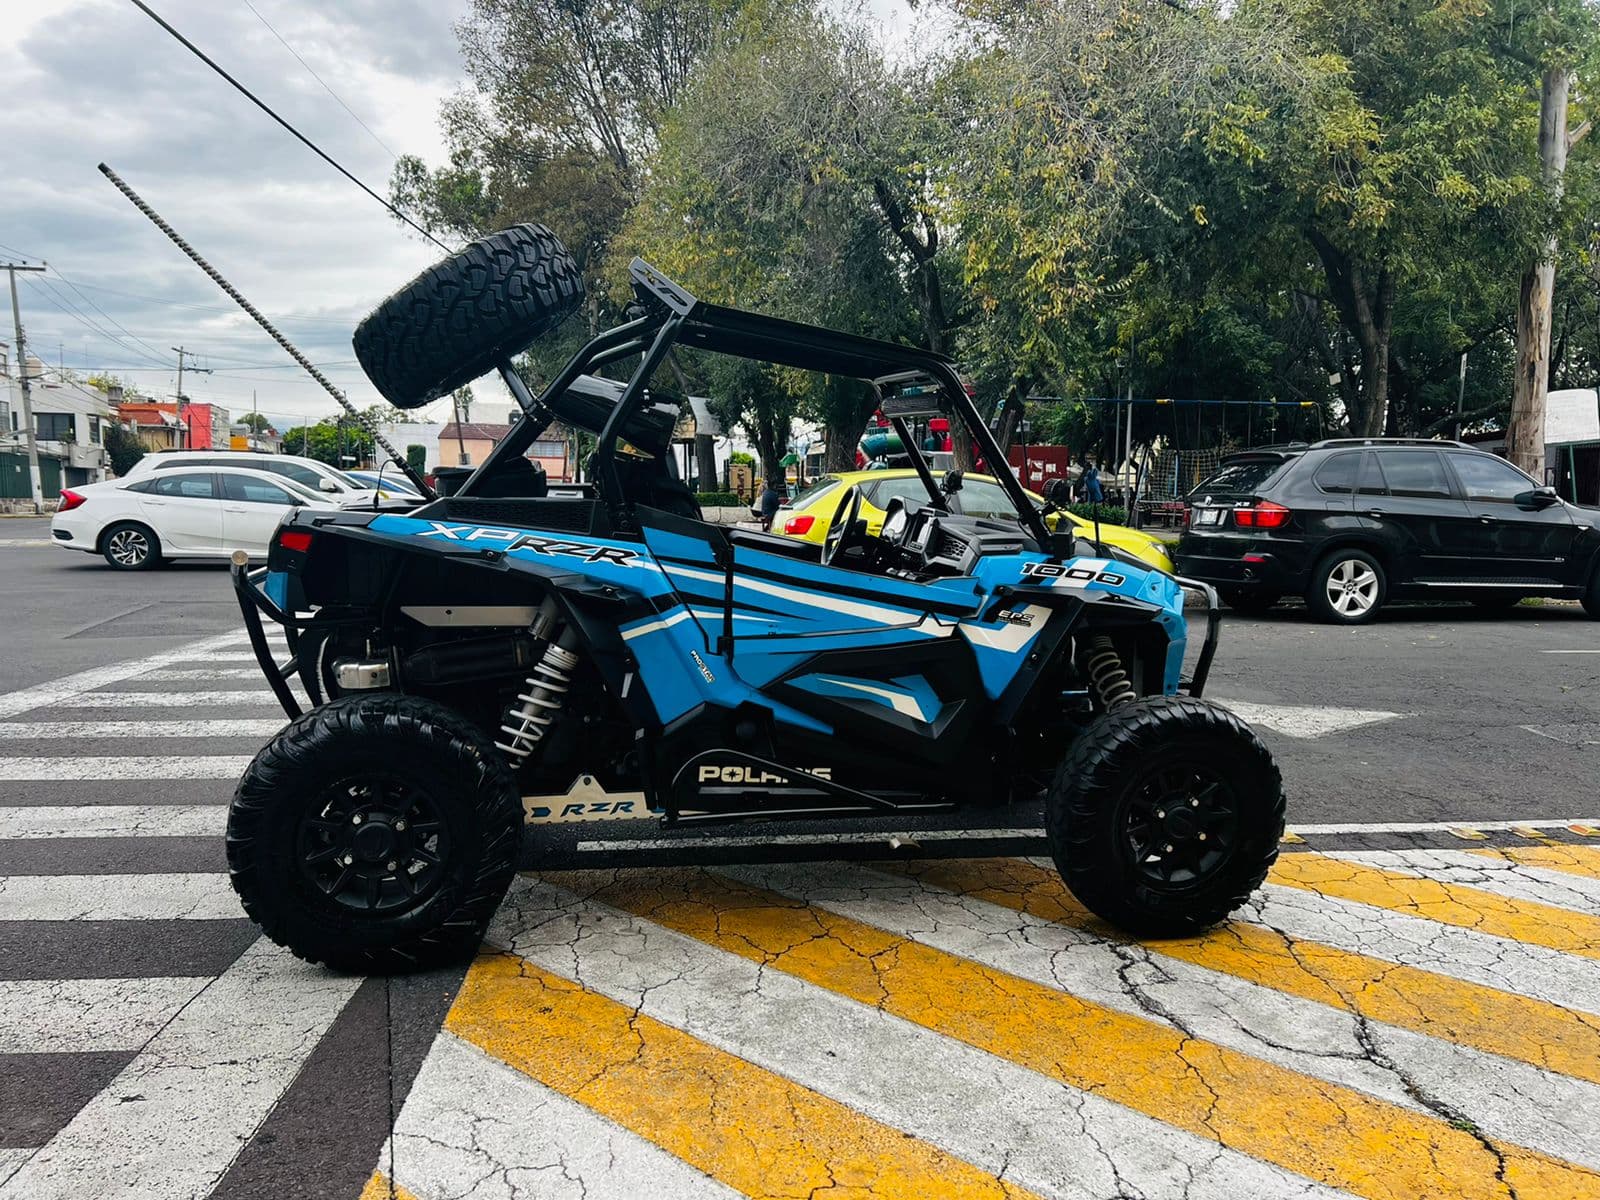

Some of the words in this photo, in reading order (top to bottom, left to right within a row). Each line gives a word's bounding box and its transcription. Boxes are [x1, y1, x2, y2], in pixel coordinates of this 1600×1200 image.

[416, 521, 519, 541] XP
[506, 534, 639, 568] RZR
[1020, 562, 1125, 587] 1000
[998, 609, 1035, 622] EPS
[690, 650, 715, 682] PROSTAR
[698, 765, 832, 784] POLAS
[560, 801, 634, 817] RZR
